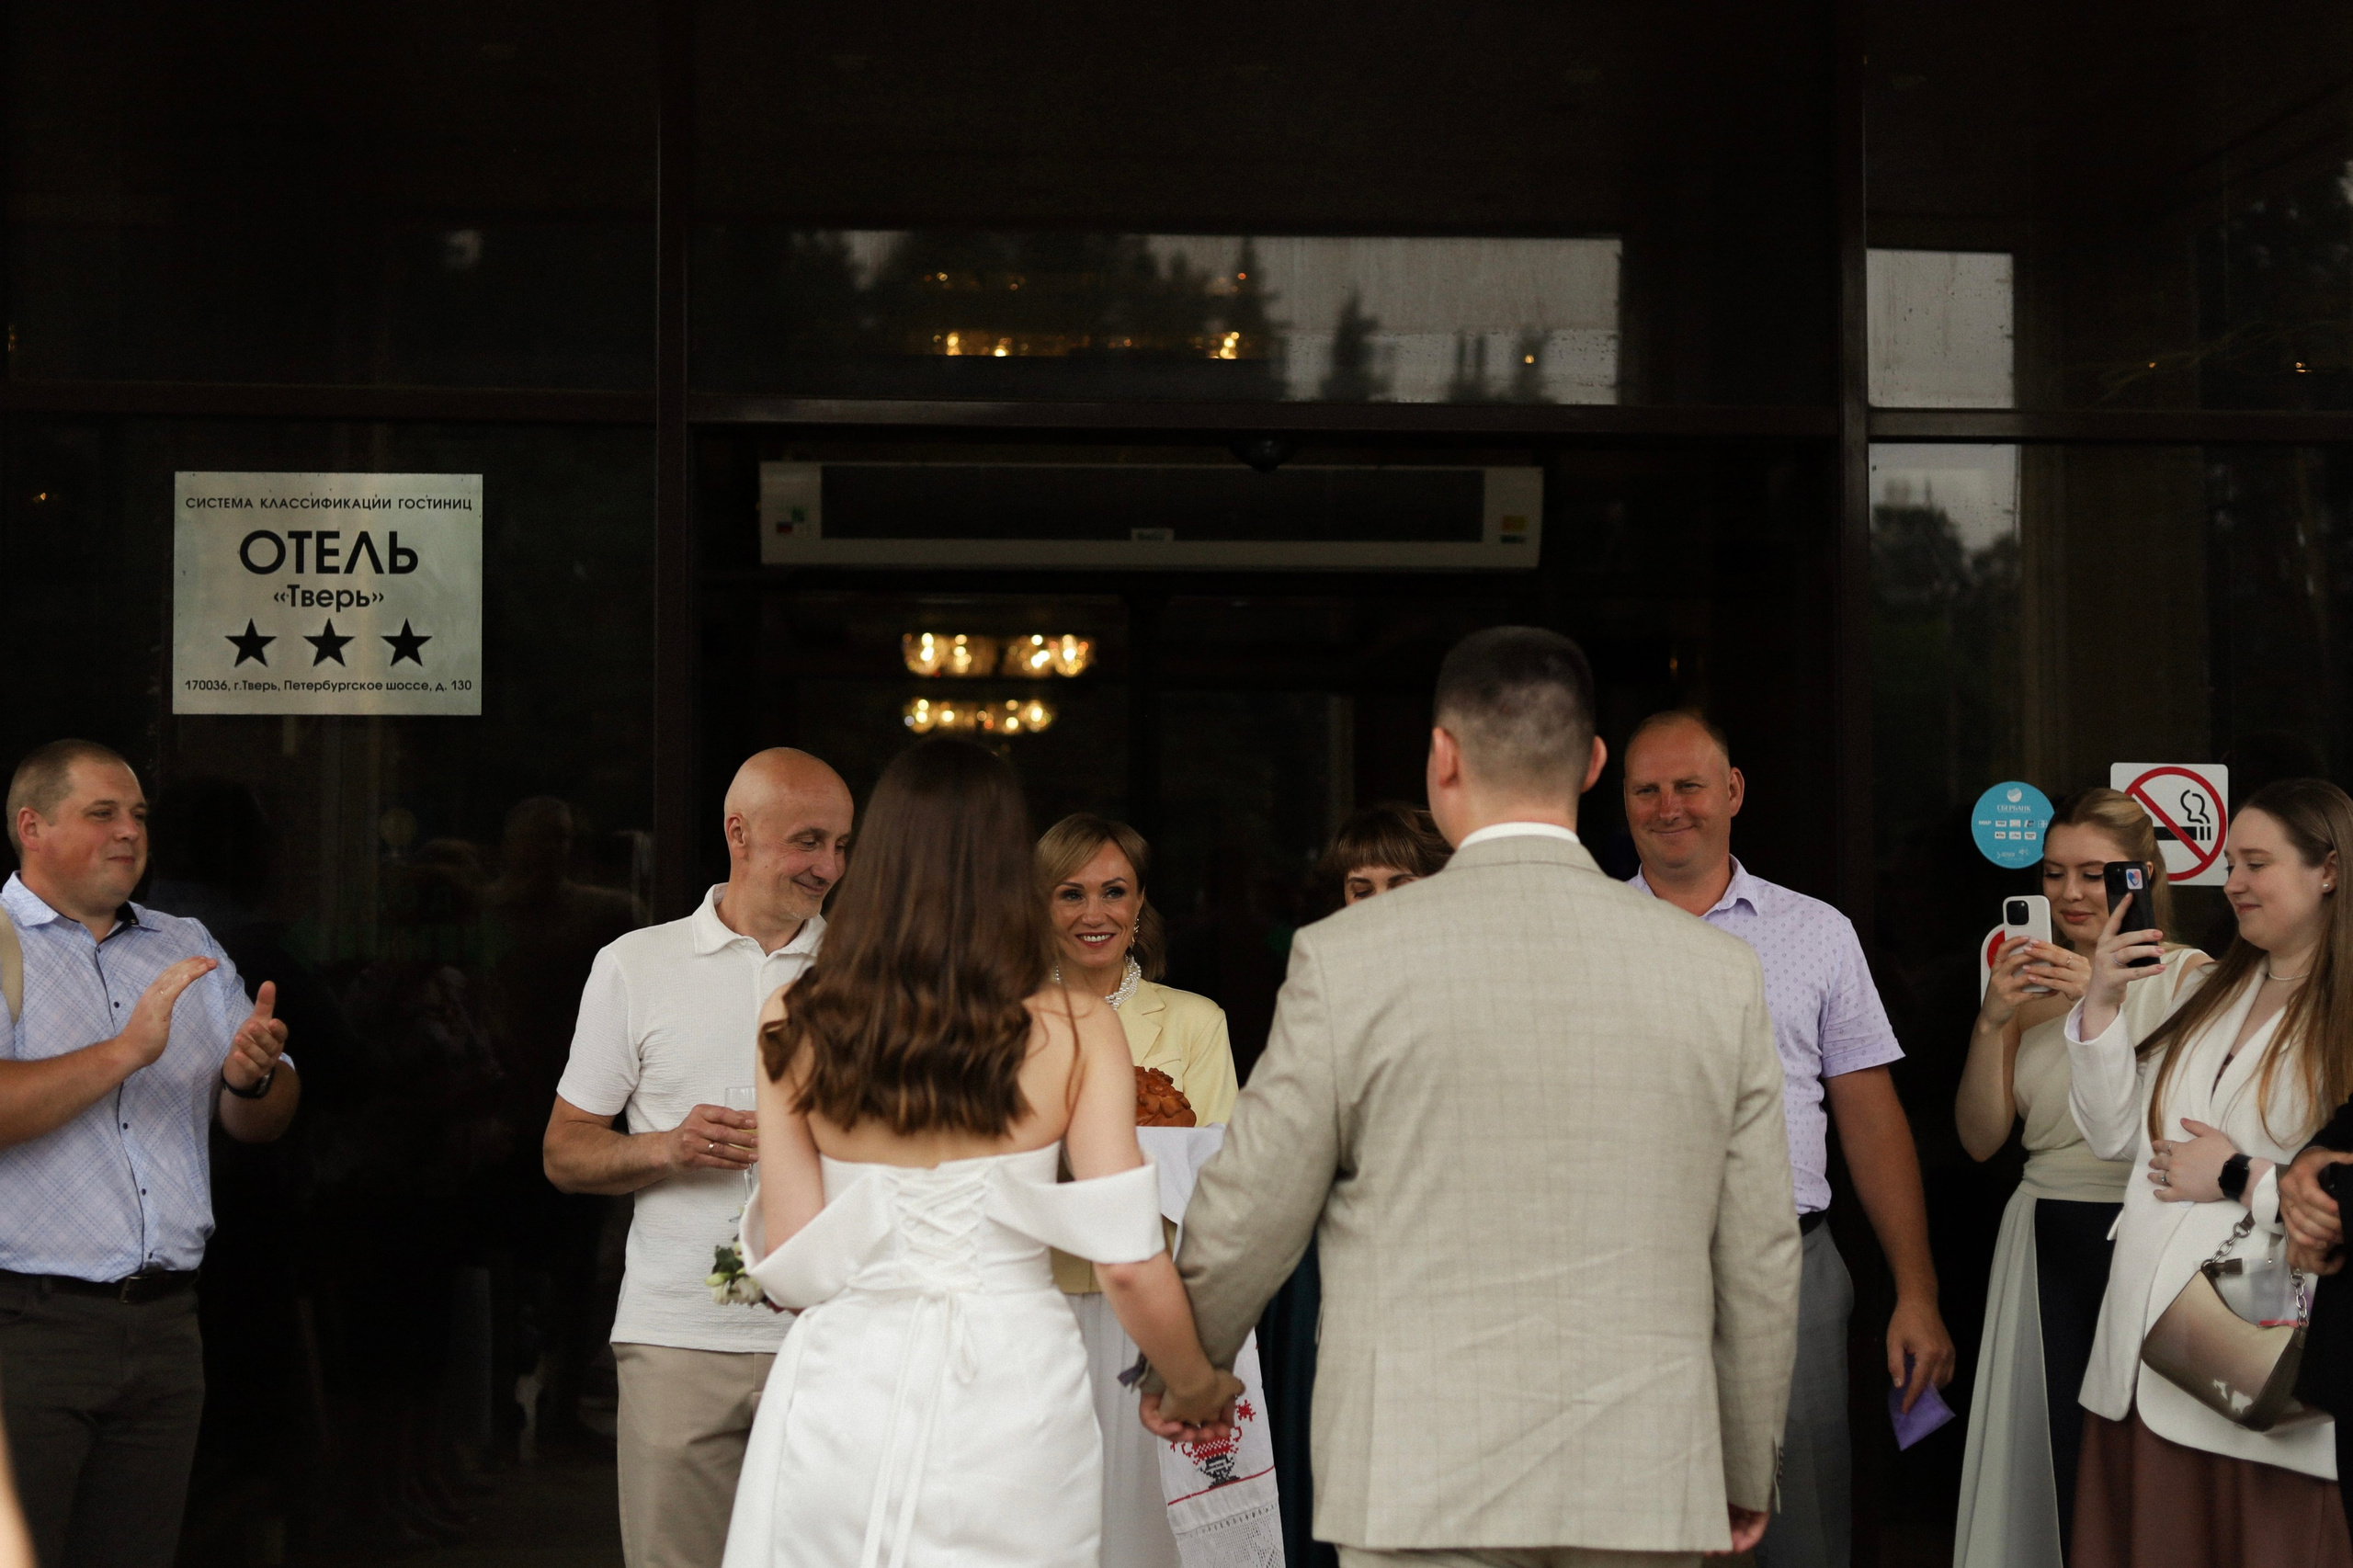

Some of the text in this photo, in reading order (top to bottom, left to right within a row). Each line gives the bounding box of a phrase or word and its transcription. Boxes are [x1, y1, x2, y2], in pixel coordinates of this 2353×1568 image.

[186, 497, 472, 511] СИСТЕМА КЛАССИФИКАЦИИ ГОСТИНИЦ
[239, 528, 419, 575] ОТЕЛЬ
[273, 584, 384, 613] «Тверь»
[185, 679, 472, 693] 170036, г.Тверь, Петербургское шоссе, д. 130
